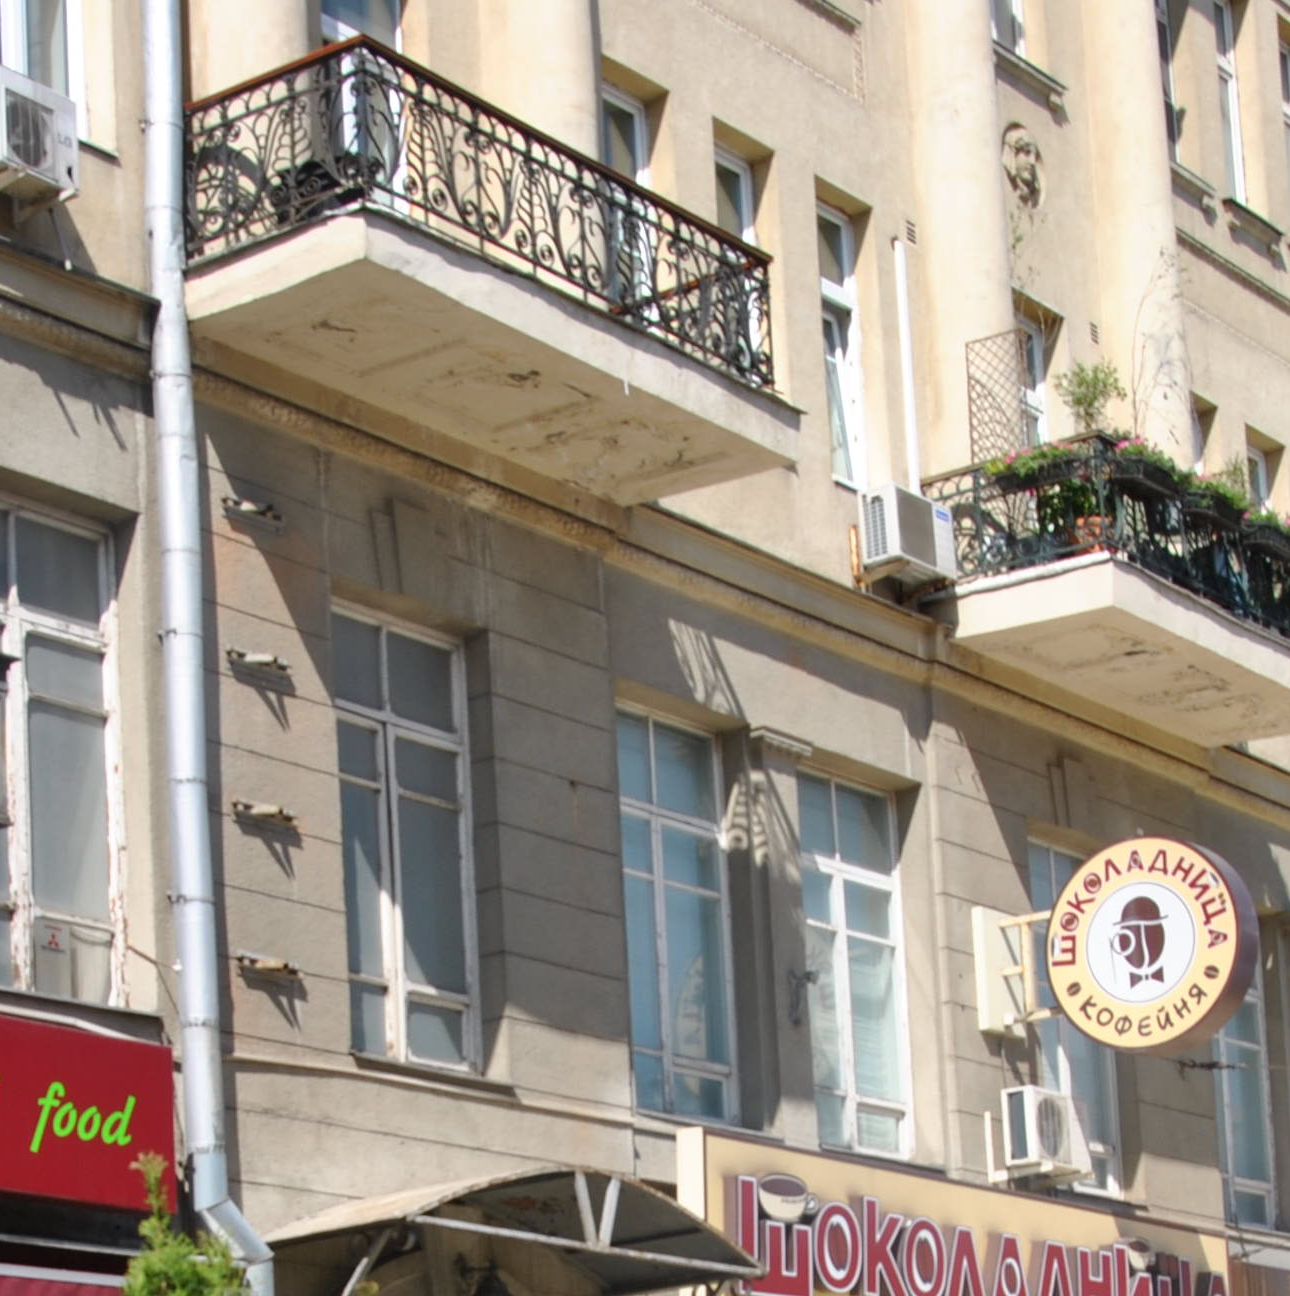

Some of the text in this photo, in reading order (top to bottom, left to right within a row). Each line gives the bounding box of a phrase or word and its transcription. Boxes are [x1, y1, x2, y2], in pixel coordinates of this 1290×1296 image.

[1052, 849, 1228, 966] ШОКОЛАДНИЦА
[1079, 983, 1207, 1037] КОФЕЙНЯ
[30, 1081, 137, 1153] food
